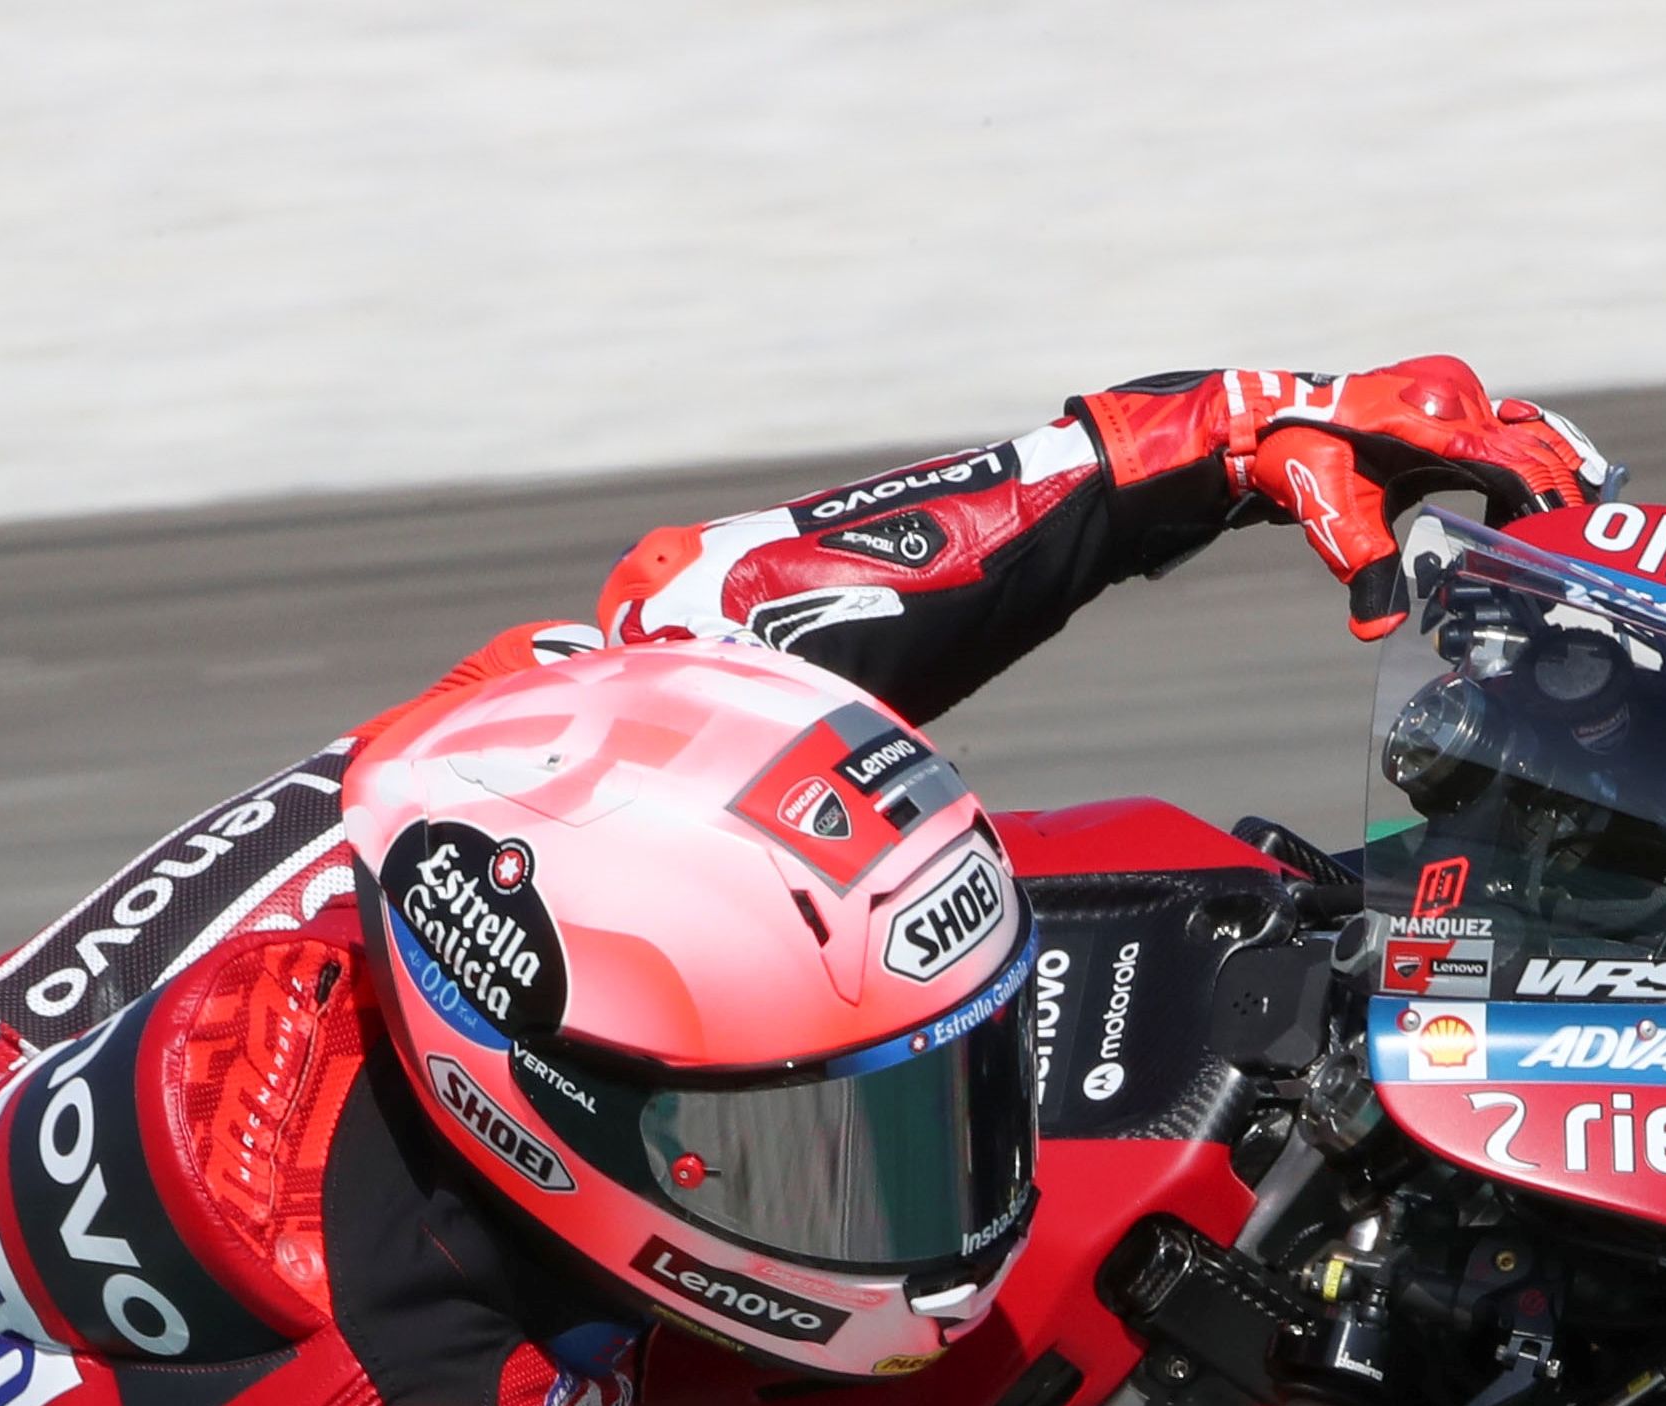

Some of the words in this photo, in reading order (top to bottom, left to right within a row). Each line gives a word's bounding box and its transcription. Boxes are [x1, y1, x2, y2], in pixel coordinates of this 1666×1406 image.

[811, 452, 1002, 518] Lenovo
[845, 738, 916, 784] Lenovo
[784, 781, 823, 822] DUCATI
[26, 772, 342, 1017] Lenovo
[416, 843, 540, 986] Estrella
[904, 863, 999, 968] SHOEI
[1390, 917, 1493, 936] MARQUEZ
[403, 884, 511, 1019] Galicia
[1432, 961, 1484, 974] Lenovo
[934, 998, 993, 1045] Estrella
[1100, 942, 1140, 1059] motorola
[513, 1041, 596, 1114] VERTICAL
[442, 1072, 554, 1182] SHOEI
[651, 1251, 822, 1331] Lenovo
